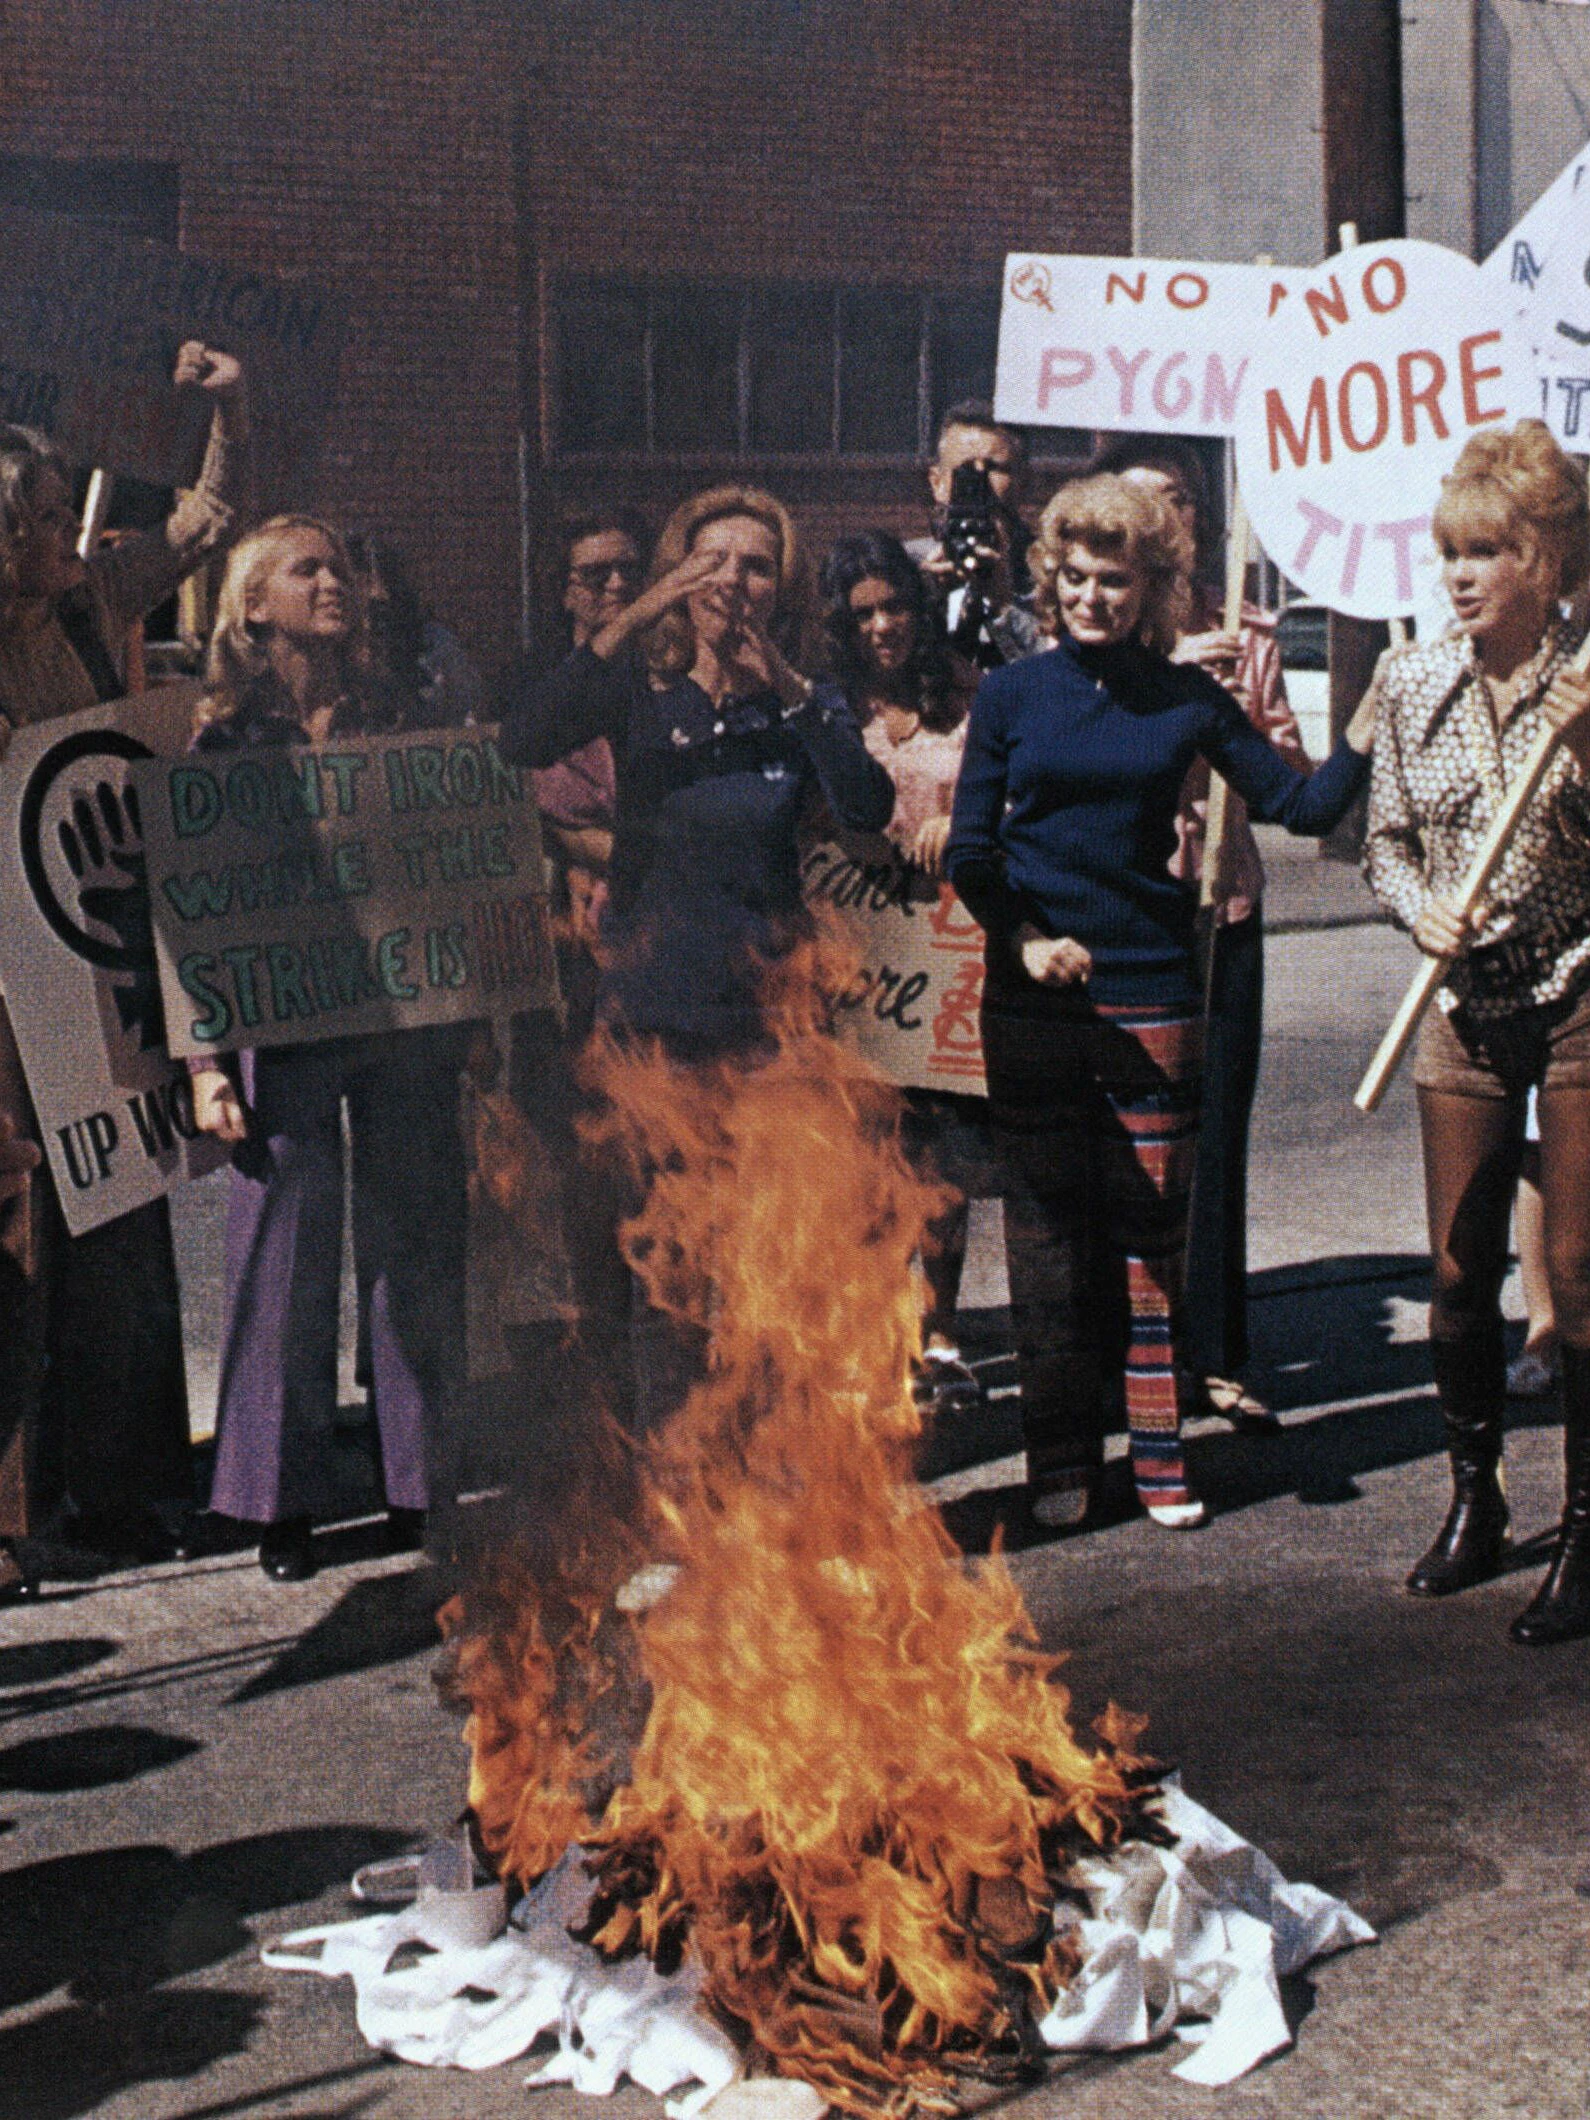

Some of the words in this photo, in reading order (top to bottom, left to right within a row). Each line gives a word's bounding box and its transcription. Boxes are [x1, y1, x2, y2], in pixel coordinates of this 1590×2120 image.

[1105, 271, 1209, 309] NO
[1304, 257, 1407, 338] NO
[1264, 329, 1507, 473] MORE
[1293, 497, 1431, 601] TIT
[385, 739, 523, 813] IRON
[163, 845, 371, 920] WHILE
[396, 824, 516, 888] THE
[178, 929, 418, 1042] STRIKE
[425, 922, 468, 988] IS
[57, 1111, 118, 1188] UP
[127, 1079, 198, 1157] WO
